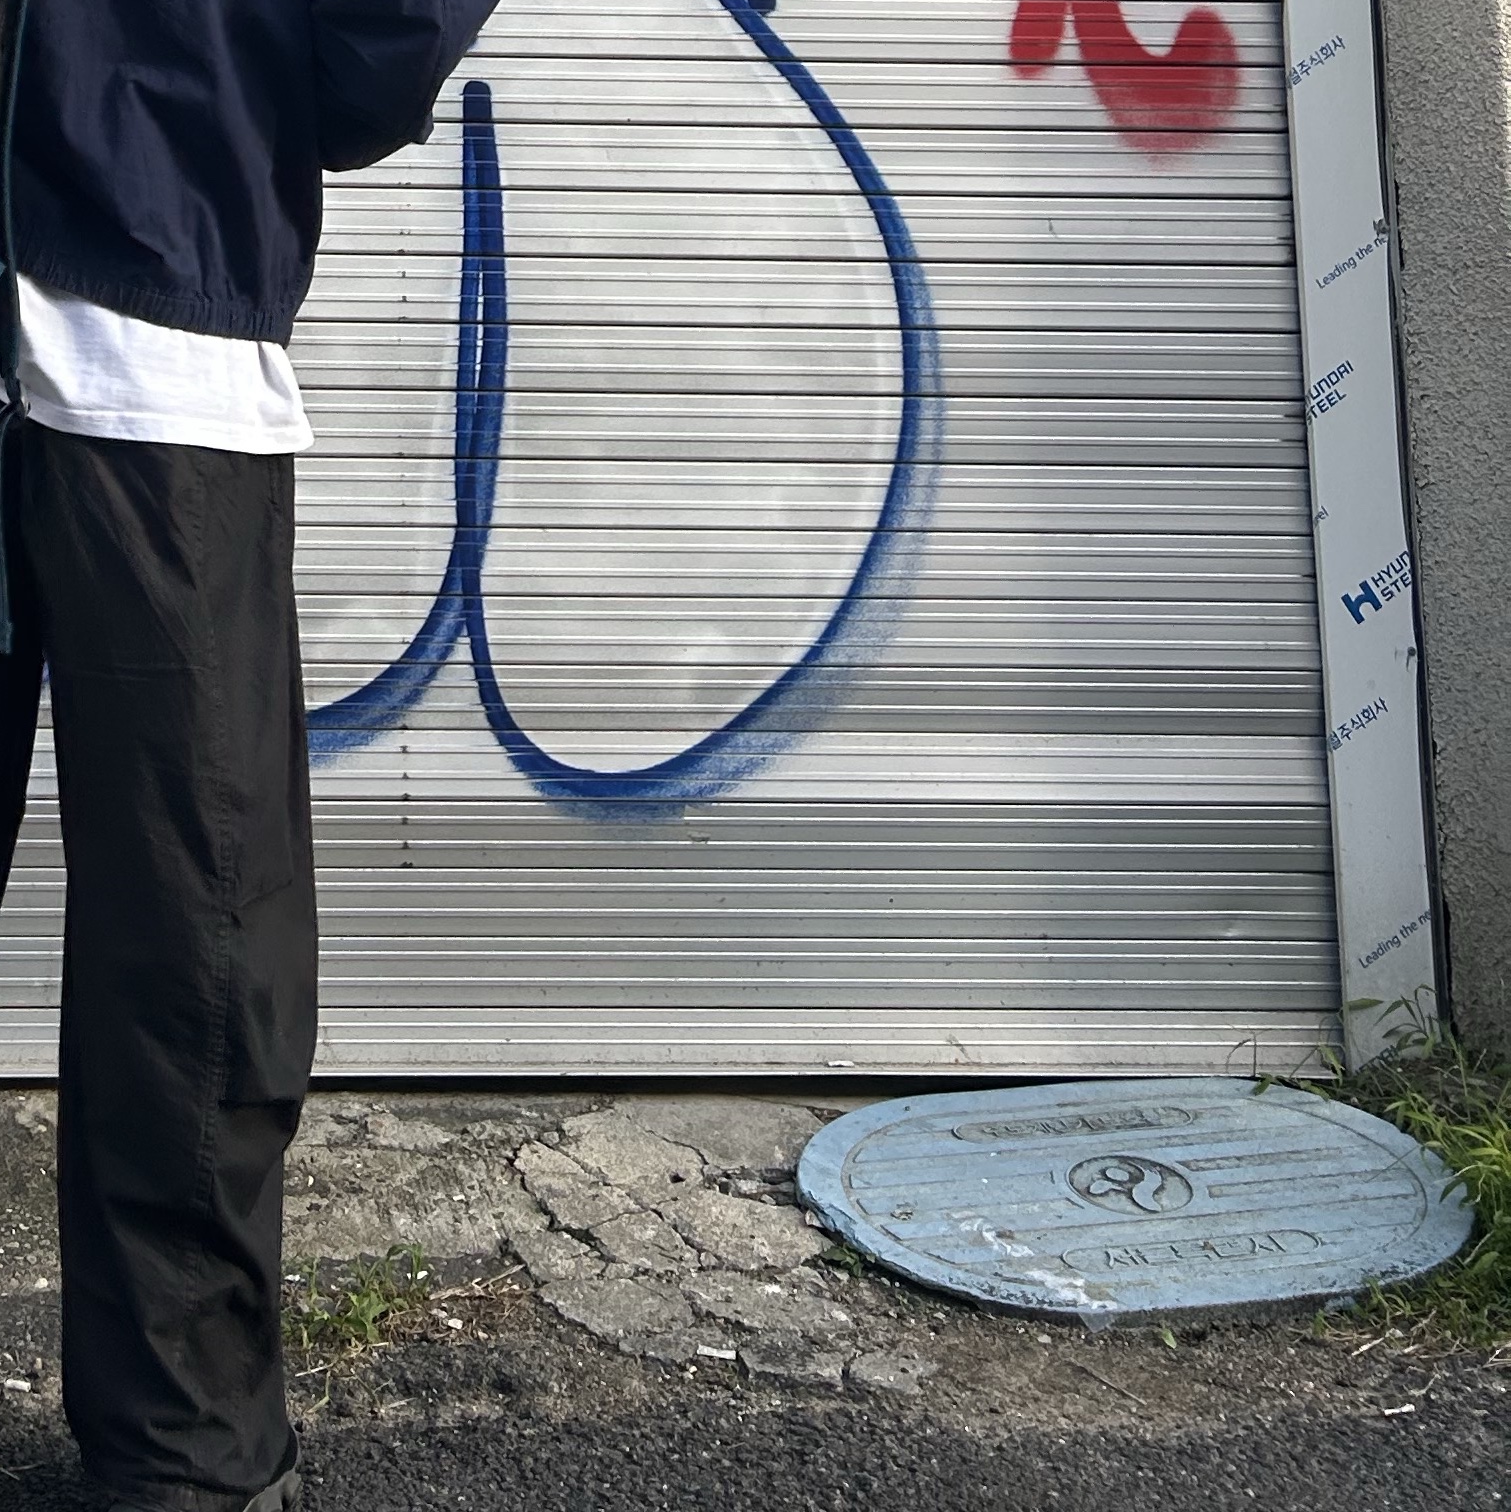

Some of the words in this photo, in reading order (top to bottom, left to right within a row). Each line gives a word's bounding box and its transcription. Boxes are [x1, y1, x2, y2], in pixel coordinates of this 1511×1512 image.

[1315, 256, 1358, 290] Leading
[1355, 243, 1374, 260] the
[1380, 568, 1412, 602] STE
[1358, 935, 1402, 969] Leading
[1399, 921, 1419, 939] the
